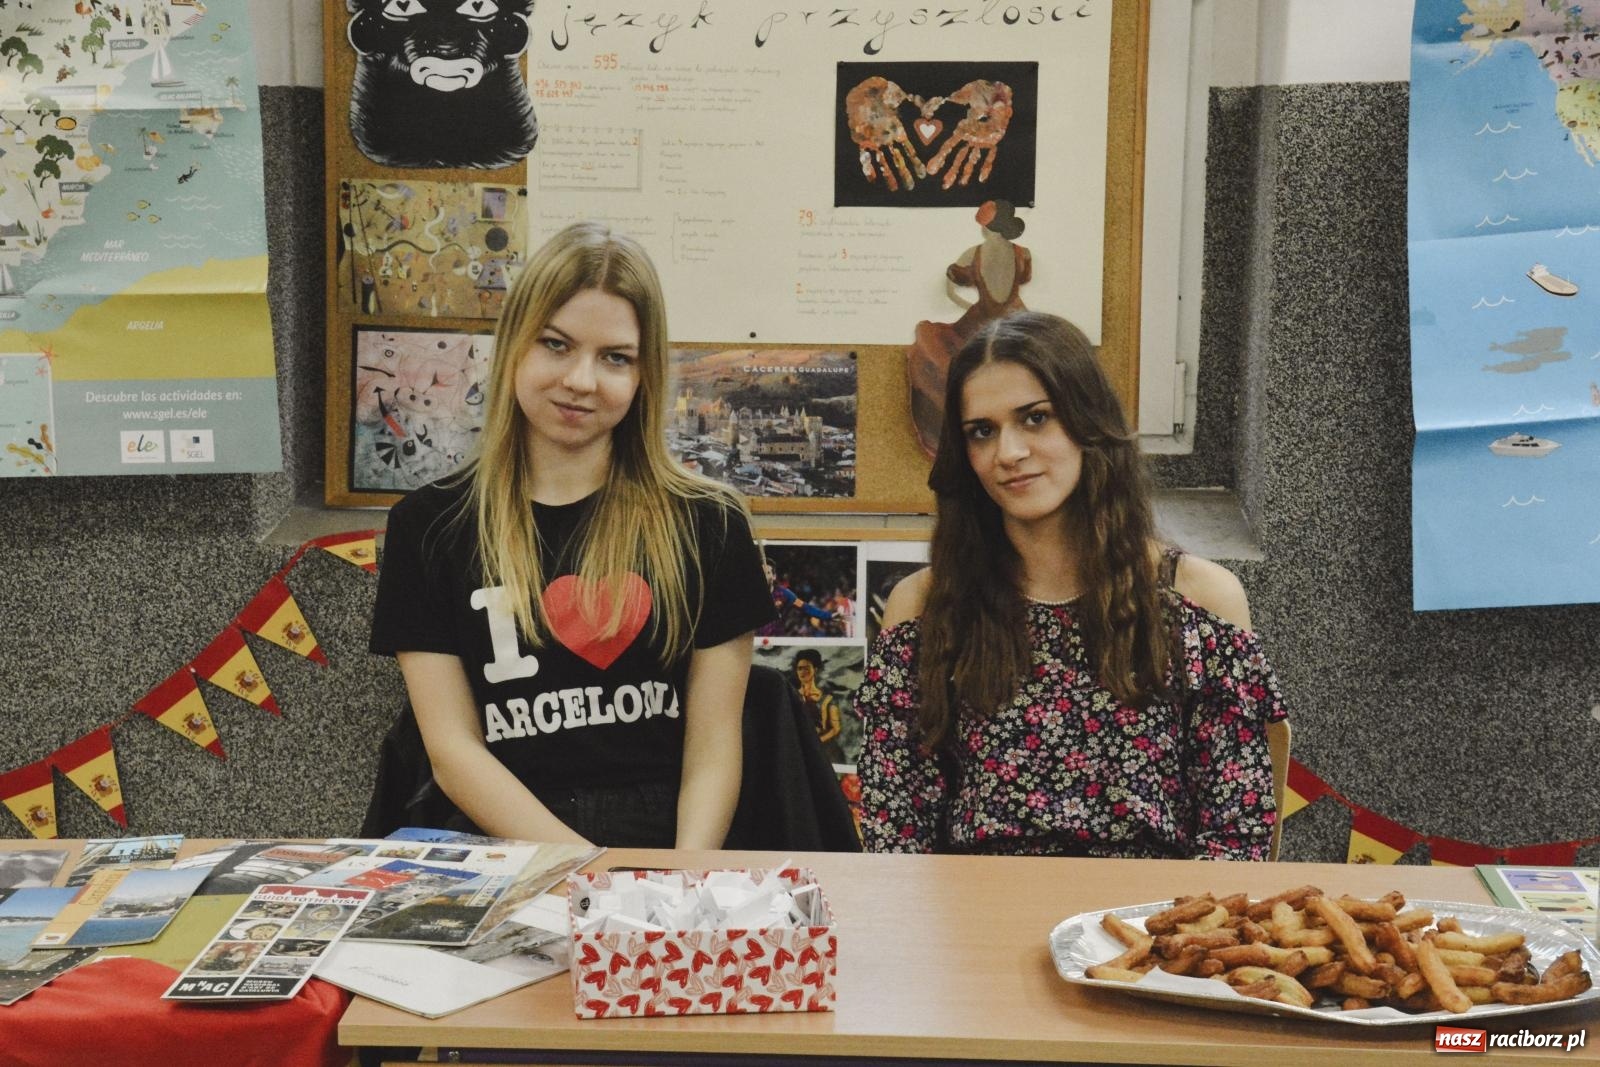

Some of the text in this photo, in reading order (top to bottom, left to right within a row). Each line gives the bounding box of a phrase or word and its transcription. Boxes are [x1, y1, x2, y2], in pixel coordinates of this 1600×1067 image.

[593, 53, 618, 71] 595
[104, 239, 125, 248] MAR
[127, 320, 164, 330] ARGELIA
[86, 391, 138, 403] Descubre
[141, 391, 157, 402] las
[159, 389, 223, 401] actividades
[128, 434, 158, 452] ele
[470, 586, 539, 684] I
[485, 680, 680, 743] ARCELON
